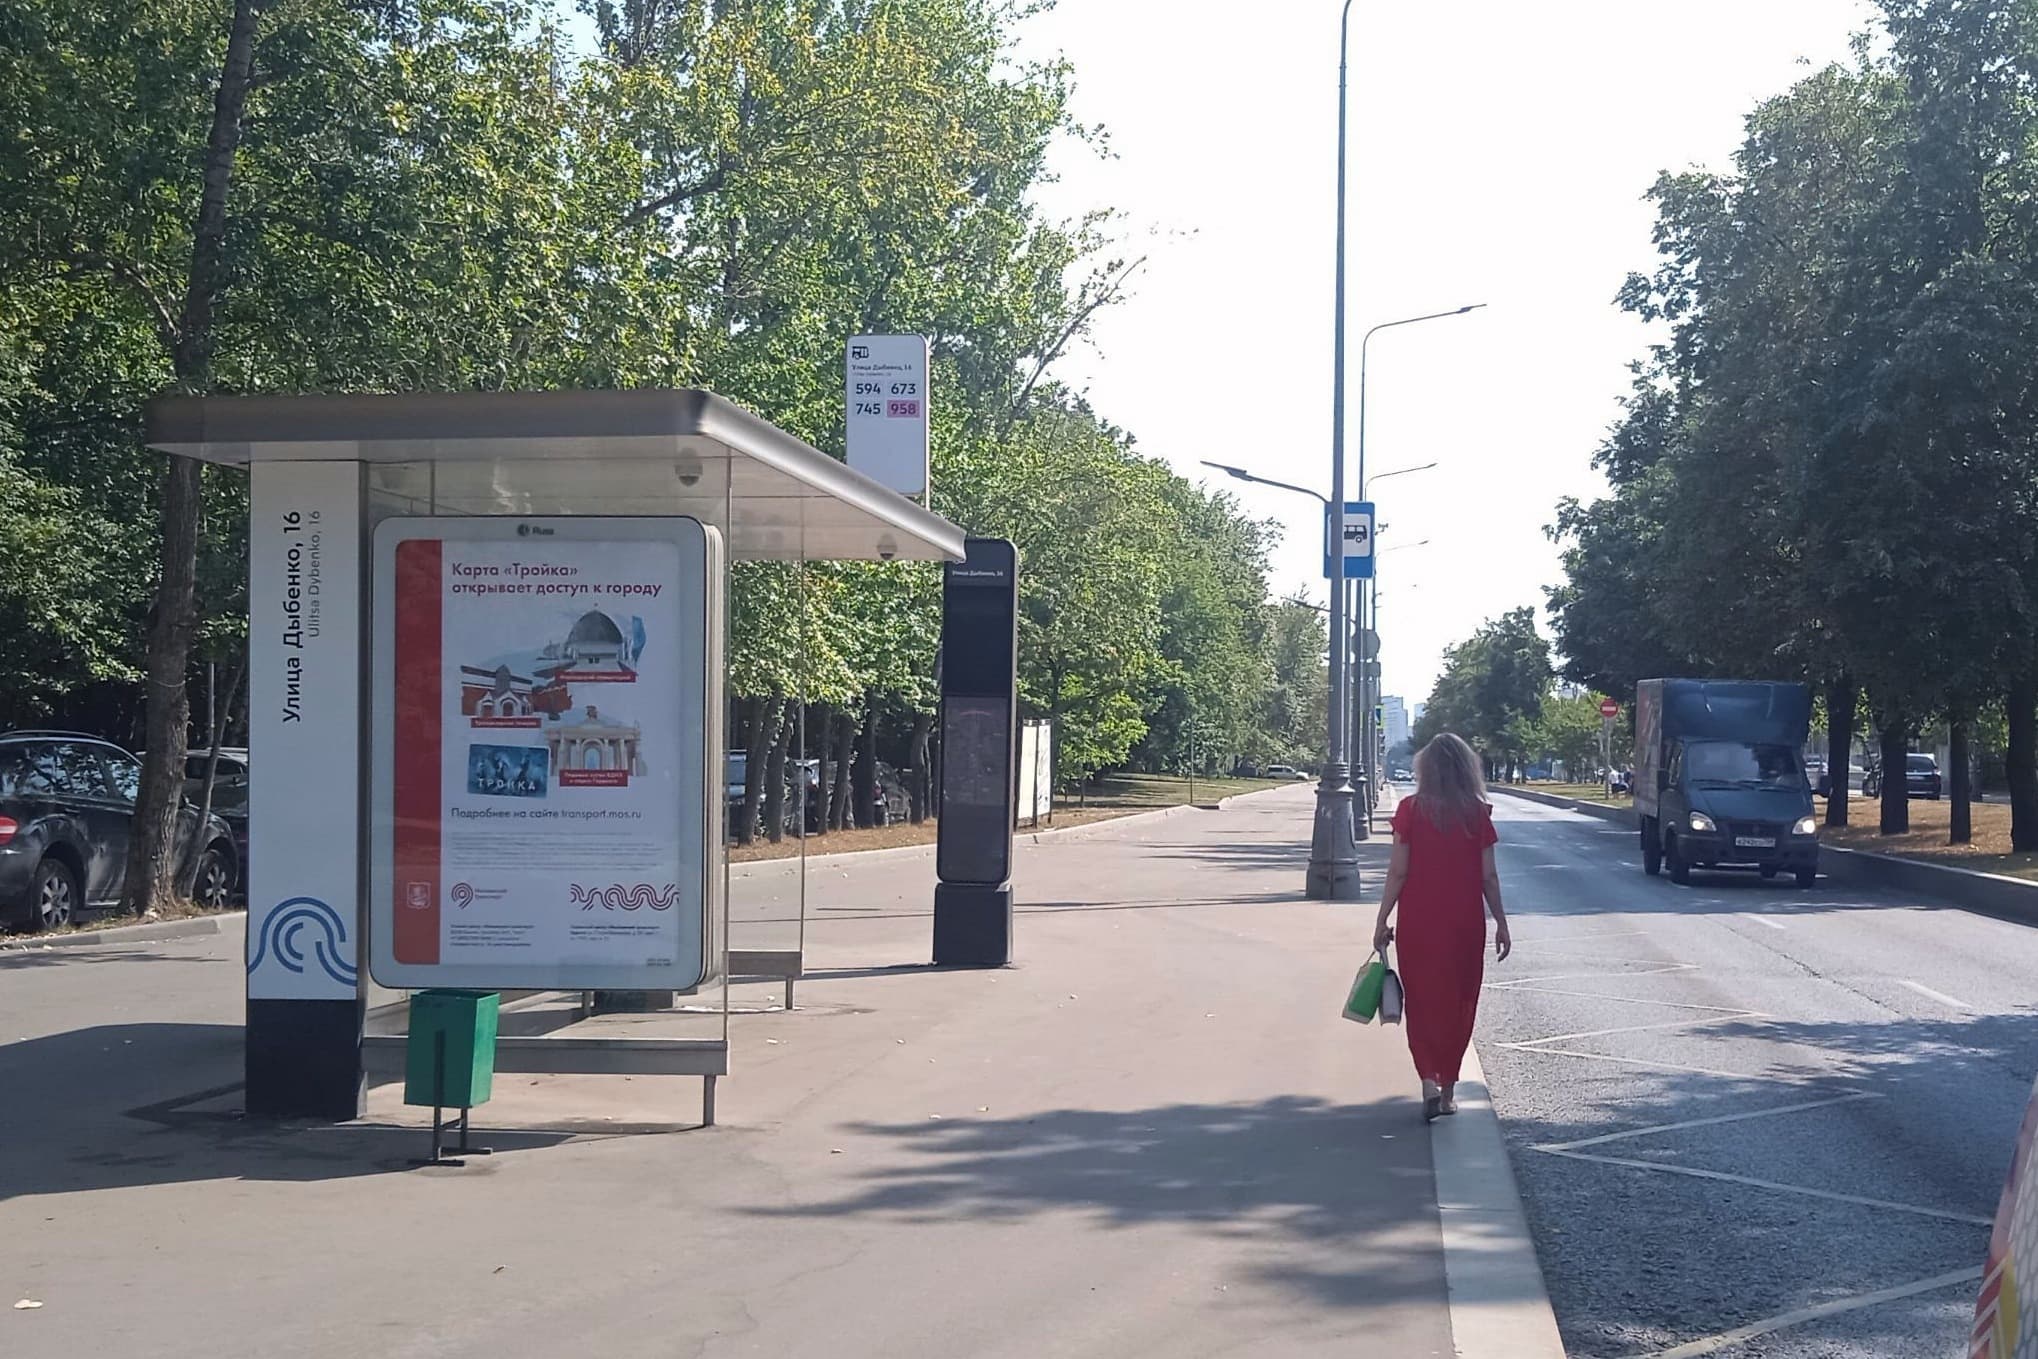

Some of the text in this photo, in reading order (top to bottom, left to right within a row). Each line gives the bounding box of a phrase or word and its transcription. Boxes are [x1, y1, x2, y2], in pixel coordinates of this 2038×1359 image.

[855, 383, 916, 395] 594 673
[855, 403, 916, 415] 745 958
[308, 510, 322, 638] Ulitsa Dybenko, 16
[452, 562, 578, 579] Карта «Тройка»
[452, 584, 662, 598] открывает доступ к городу
[282, 511, 304, 722] Улица Дыбенко, 16
[451, 807, 642, 821] Подробнее на сайте transport.mos.ru
